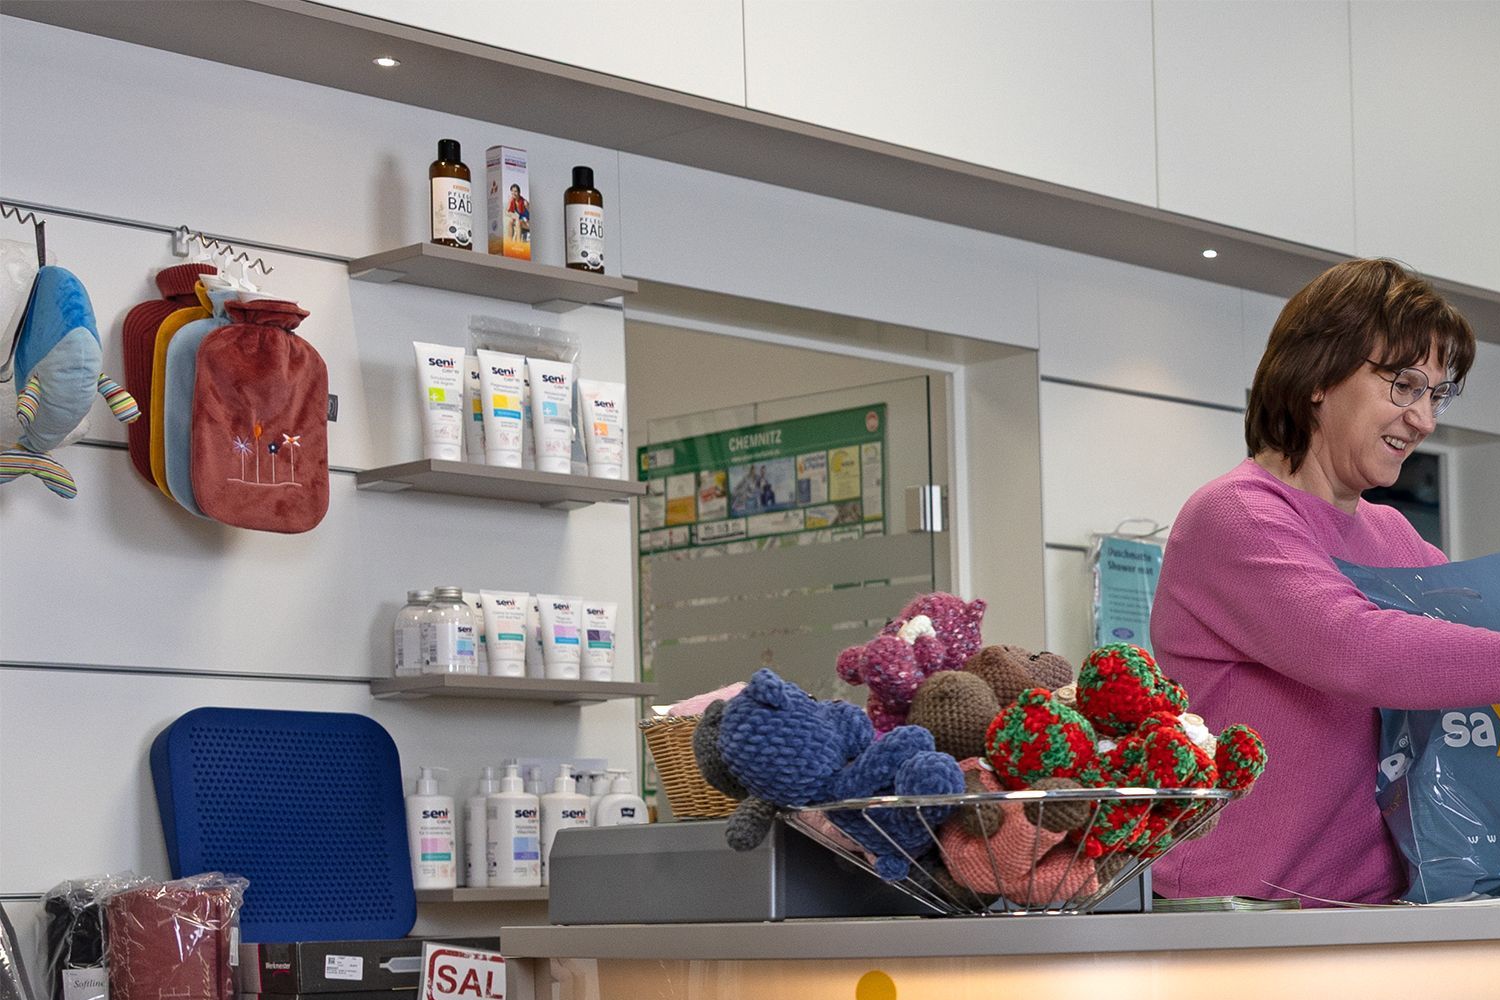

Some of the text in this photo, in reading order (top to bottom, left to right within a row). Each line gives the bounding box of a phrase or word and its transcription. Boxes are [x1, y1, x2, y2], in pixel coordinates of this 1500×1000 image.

[448, 197, 472, 214] BAD
[580, 223, 604, 239] BAD
[428, 356, 454, 368] seni
[491, 366, 514, 376] seni
[542, 373, 565, 384] seni
[594, 400, 615, 408] seni
[728, 430, 782, 452] CHEMNITZ
[553, 602, 570, 610] seni
[422, 808, 449, 819] seni
[515, 807, 538, 819] seni
[561, 808, 587, 819] seni
[435, 964, 503, 1000] SAL
